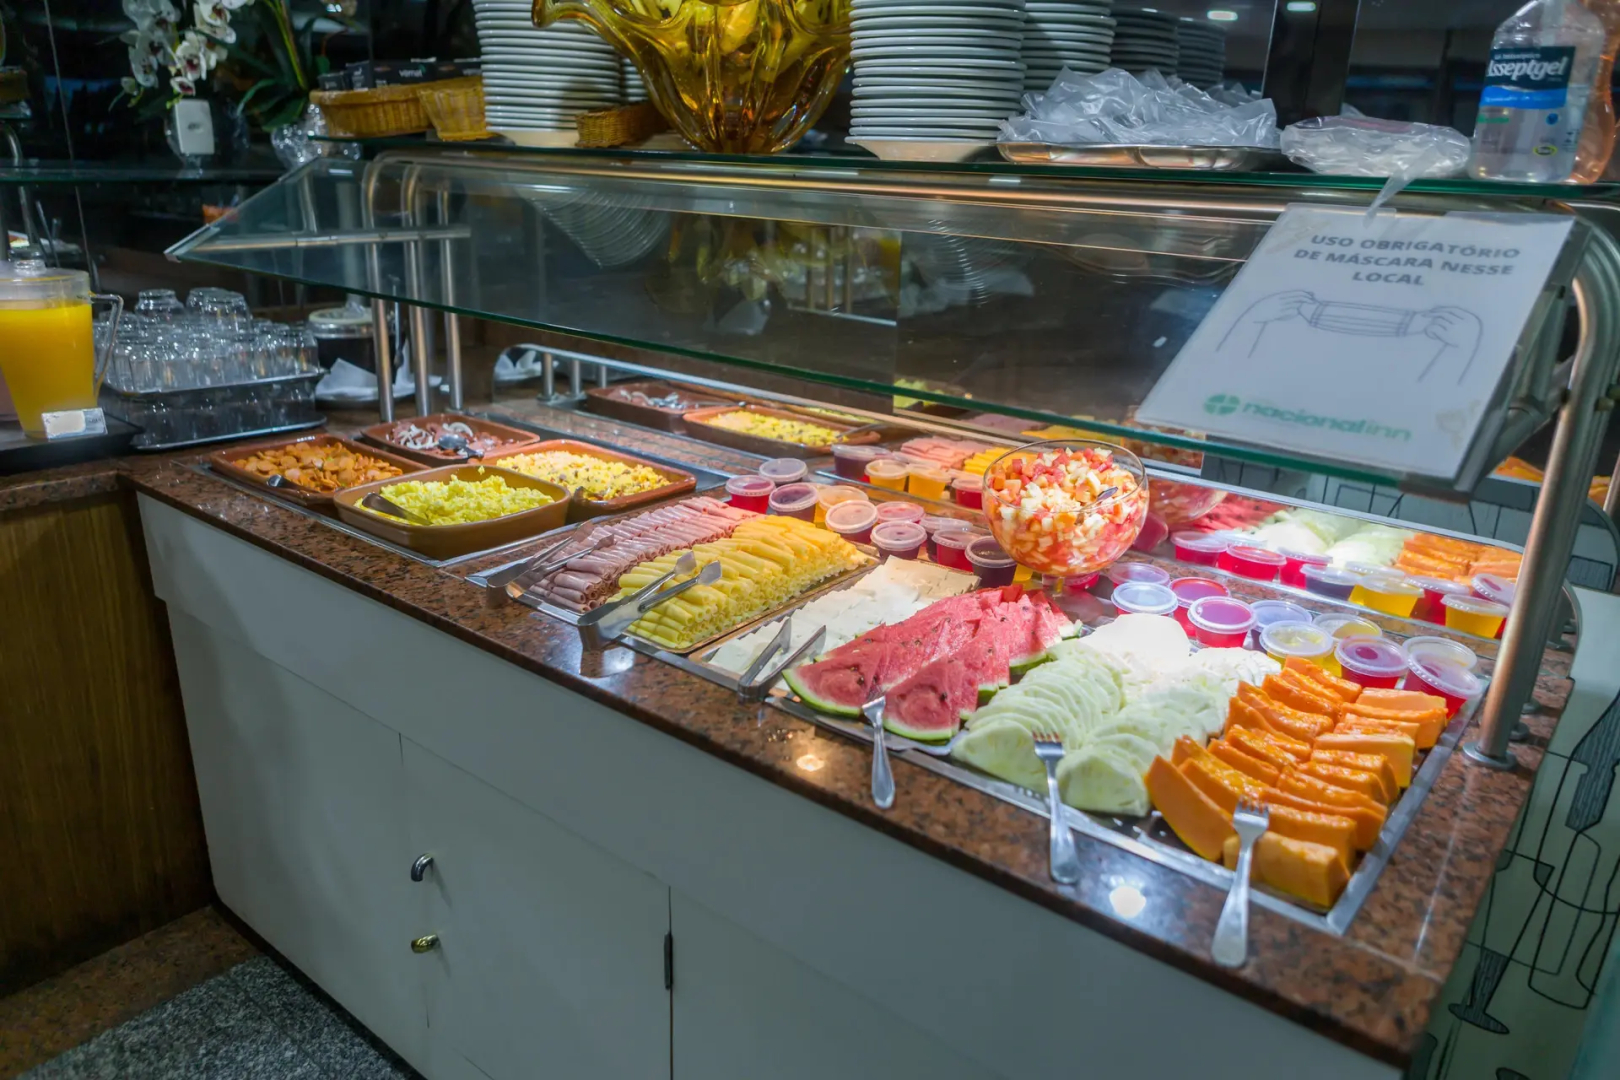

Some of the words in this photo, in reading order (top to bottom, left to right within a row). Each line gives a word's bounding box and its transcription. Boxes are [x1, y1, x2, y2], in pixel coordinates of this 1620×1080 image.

[1311, 234, 1354, 247] USO
[1360, 239, 1520, 259] OBRIGATÓRIO
[1294, 249, 1322, 261] DE
[1325, 252, 1433, 269] MÁSCARA
[1441, 261, 1513, 276] NESSE
[1352, 271, 1425, 286] LOCAL
